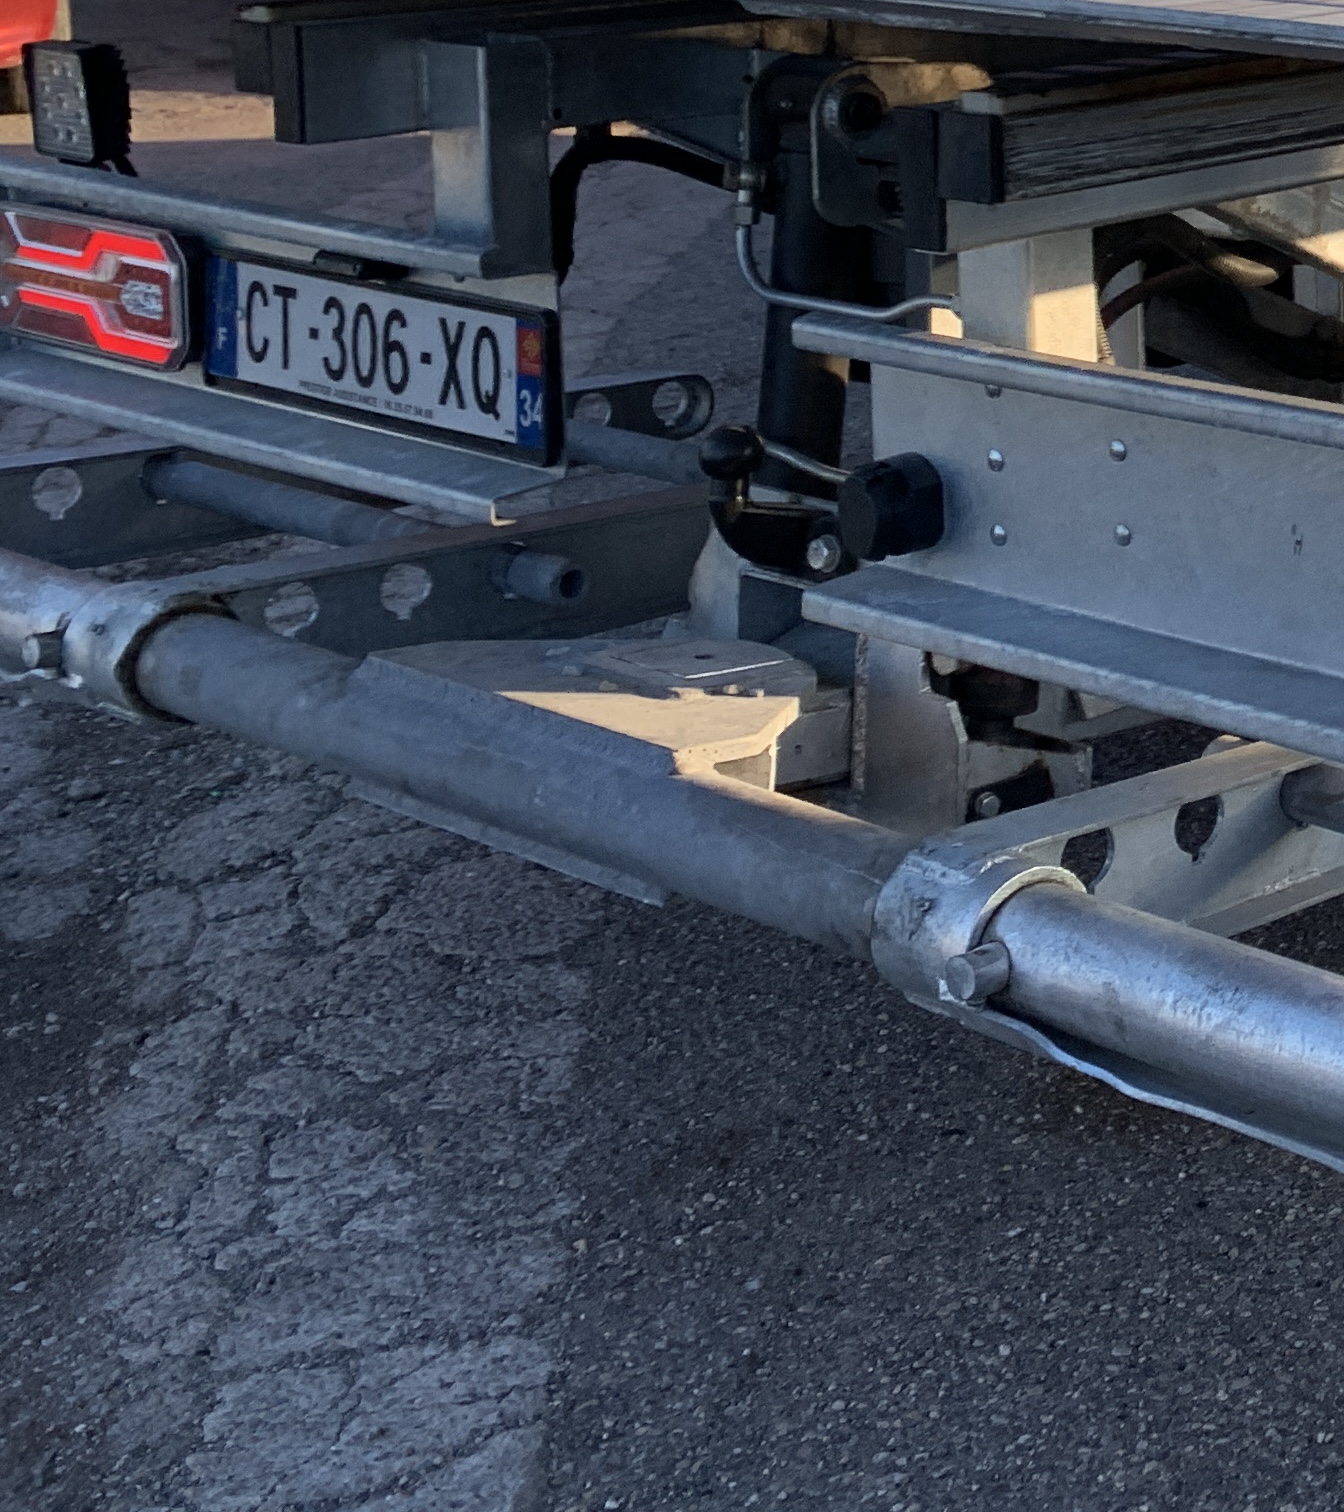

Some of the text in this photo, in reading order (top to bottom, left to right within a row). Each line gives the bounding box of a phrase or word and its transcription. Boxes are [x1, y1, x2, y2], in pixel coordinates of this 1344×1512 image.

[216, 326, 228, 349] F
[245, 280, 502, 423] CT-306-XQ
[519, 389, 544, 430] 34
